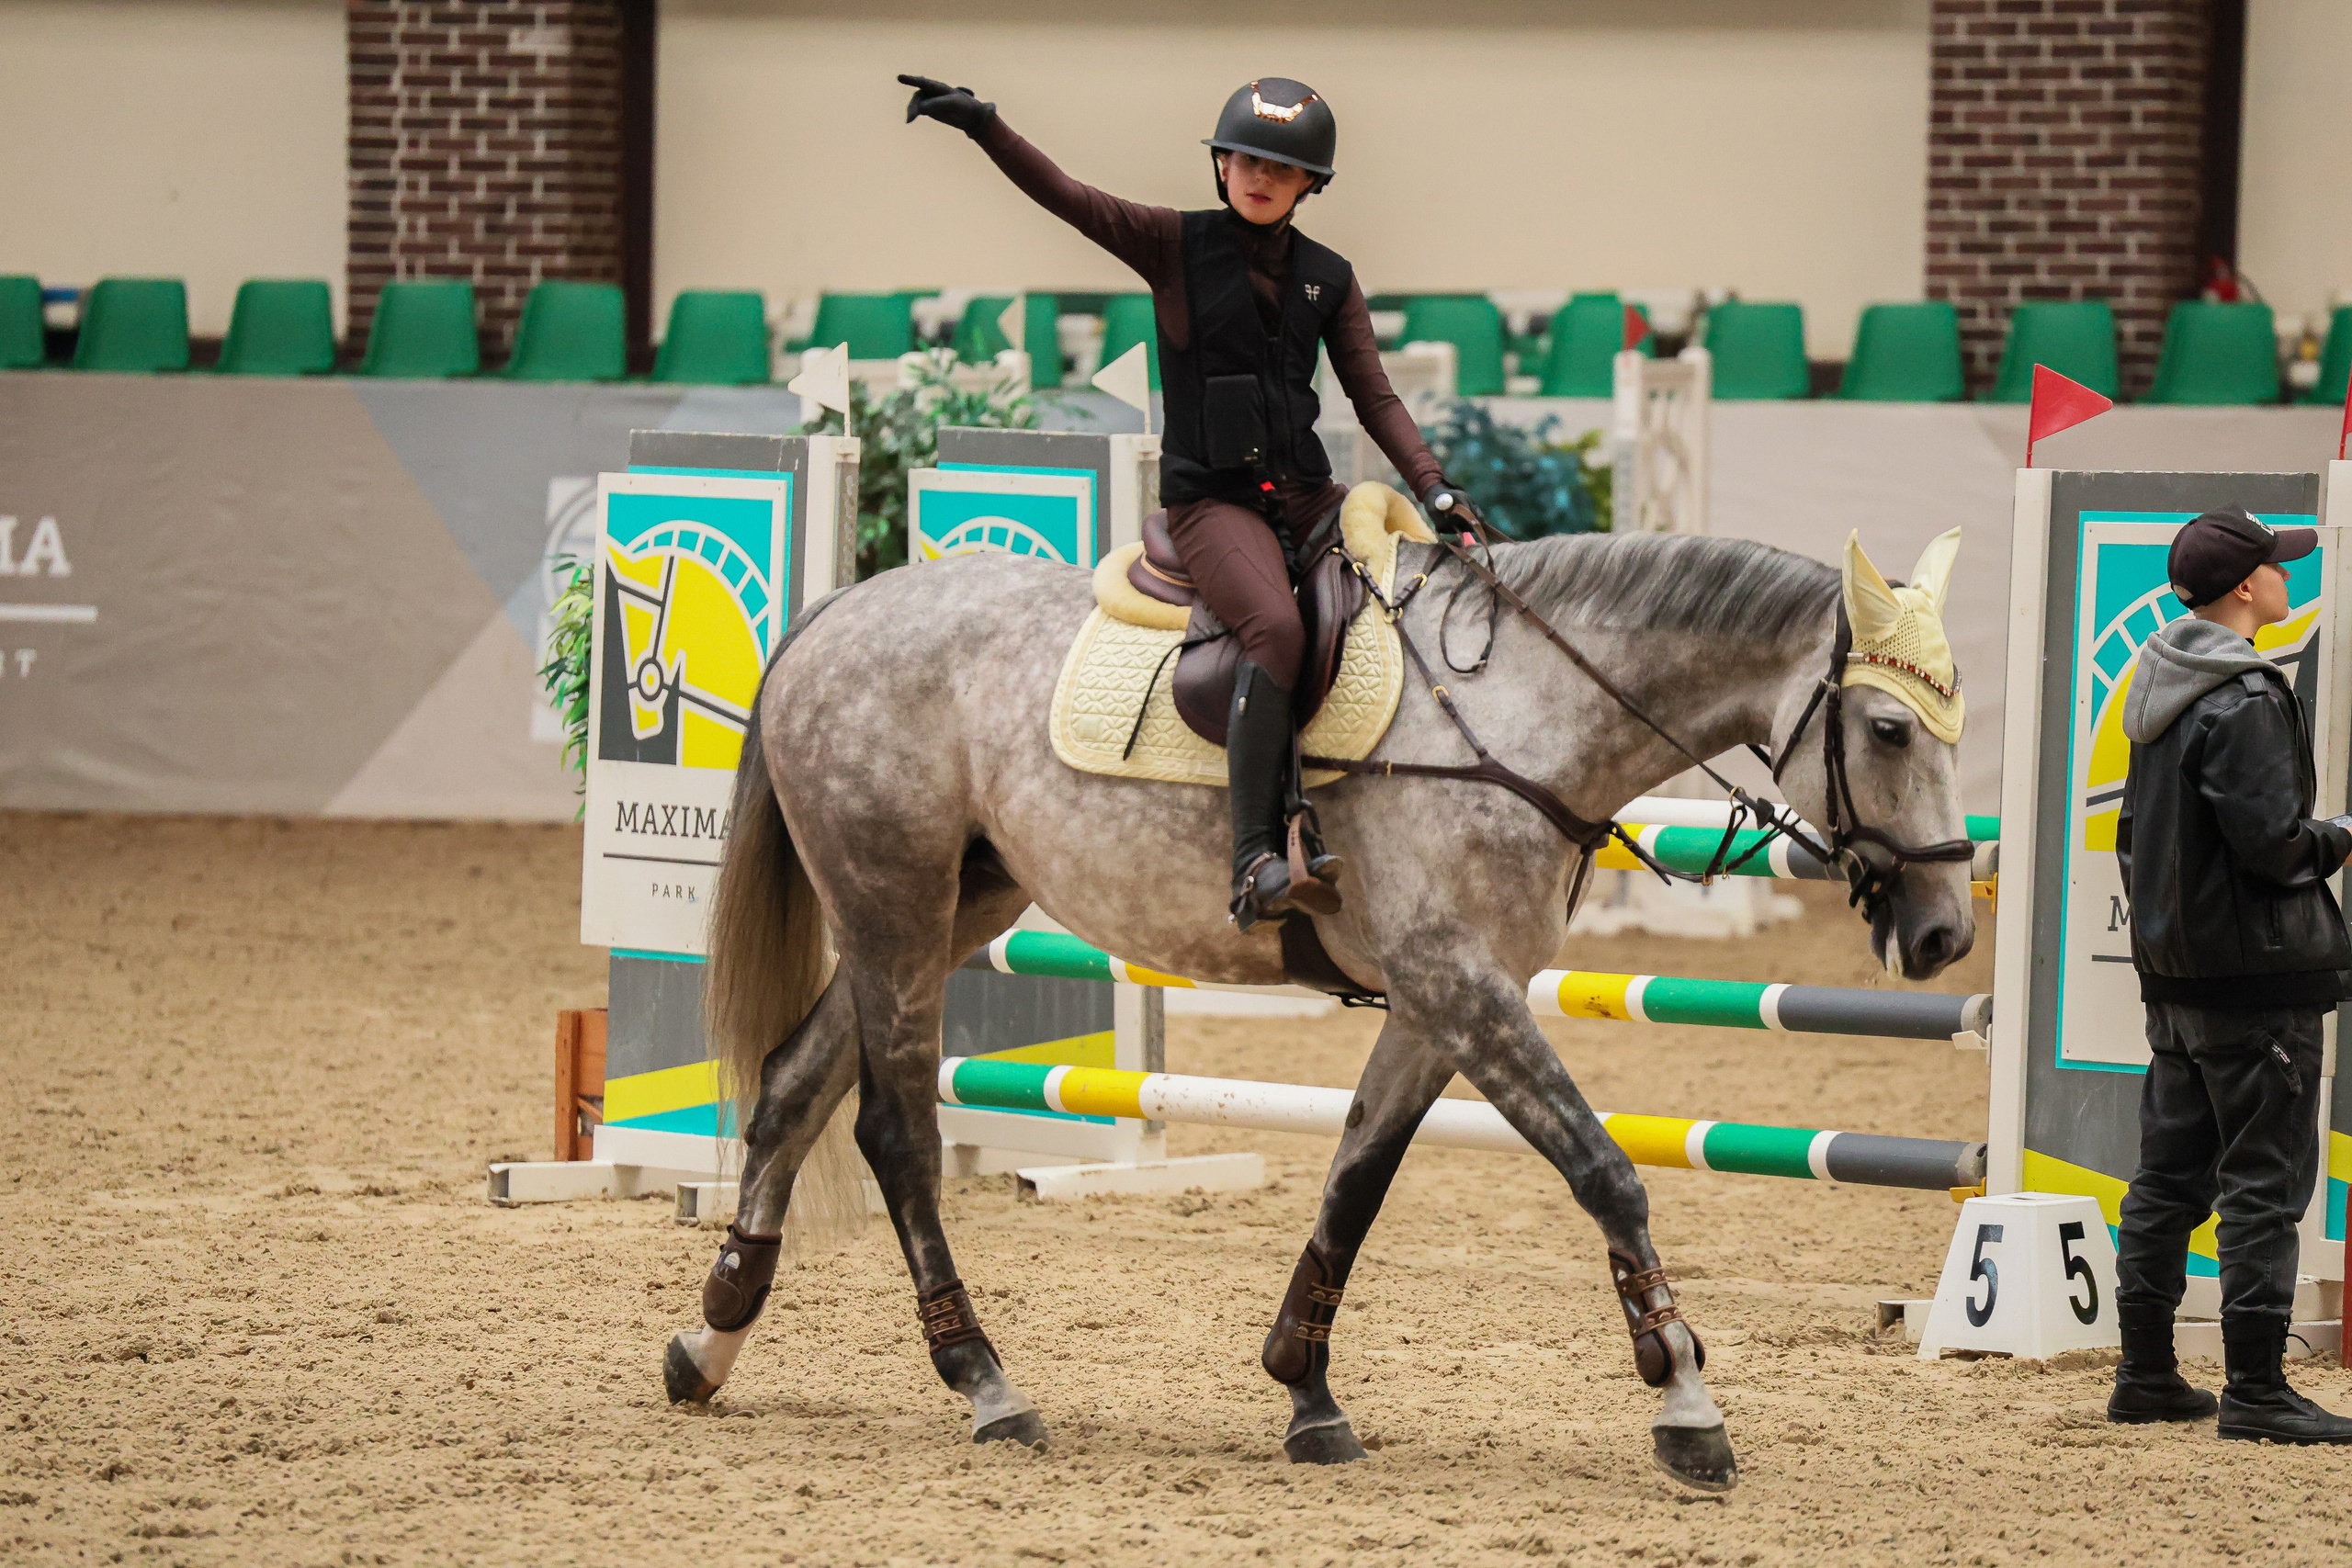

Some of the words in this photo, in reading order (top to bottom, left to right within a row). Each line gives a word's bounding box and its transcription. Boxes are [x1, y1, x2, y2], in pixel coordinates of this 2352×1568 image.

[651, 883, 696, 900] PARK
[1965, 1224, 2004, 1328] 5
[2058, 1221, 2099, 1325] 5
